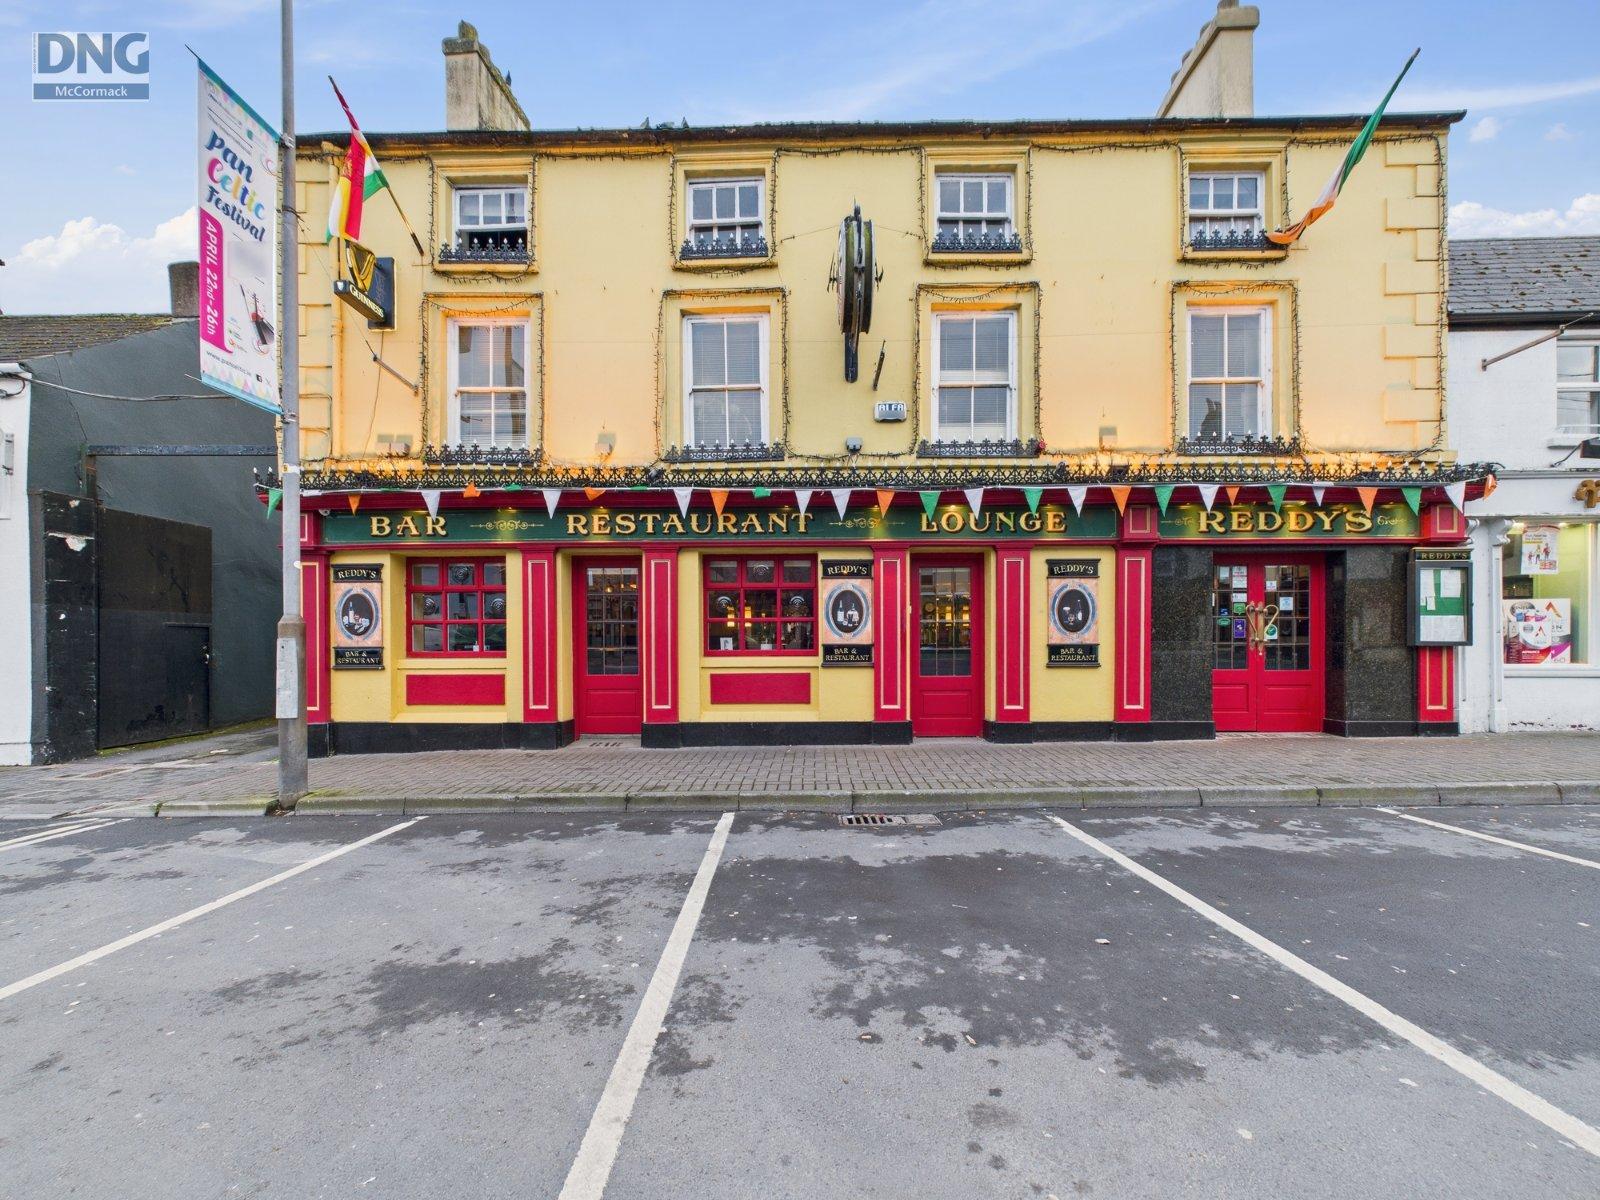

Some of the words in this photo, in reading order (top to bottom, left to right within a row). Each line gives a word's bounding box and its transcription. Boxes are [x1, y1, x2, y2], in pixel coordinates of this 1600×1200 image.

[207, 157, 265, 220] Celtic
[206, 185, 266, 242] Festival
[206, 219, 218, 265] APRIL
[370, 515, 447, 537] BAR
[566, 512, 813, 535] RESTAURANT
[920, 511, 1068, 533] LOUNGE
[1198, 507, 1374, 533] REDDY'S
[1421, 552, 1467, 560] REDDY'S
[338, 568, 377, 579] REDDY'S
[827, 564, 868, 575] REDDY'S
[1053, 564, 1094, 575] REDDY'S
[834, 647, 849, 655] BAR
[1060, 647, 1075, 655] BAR
